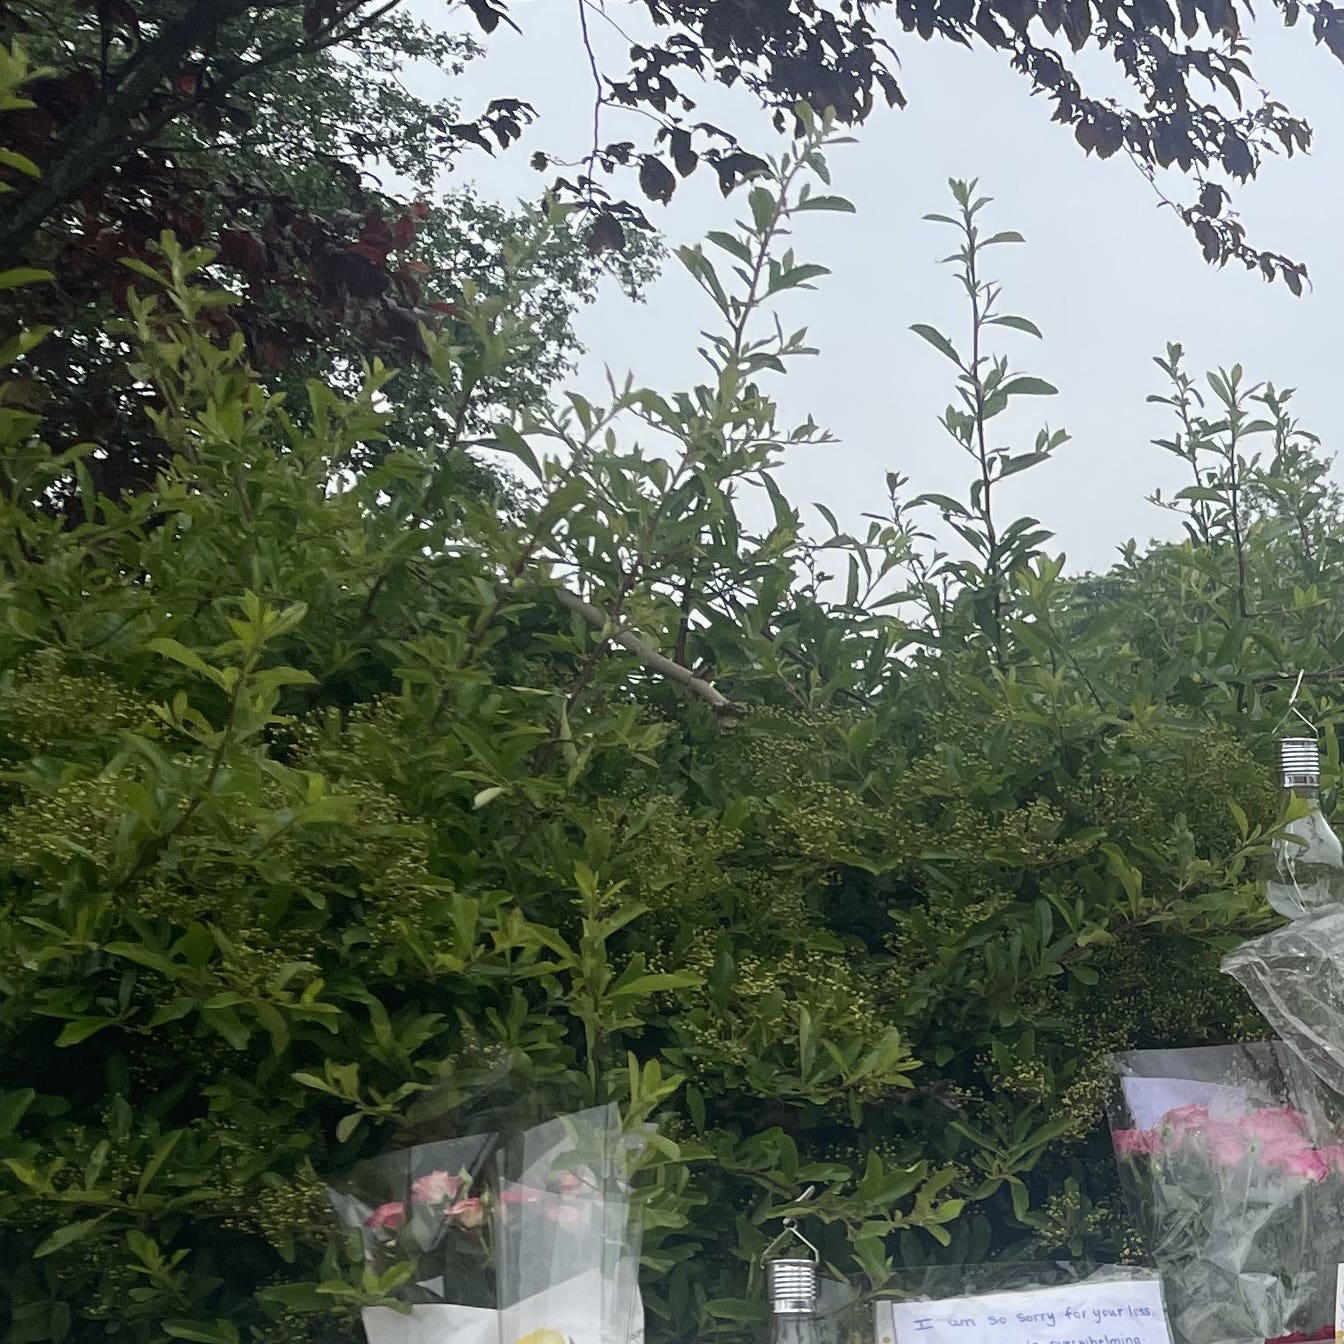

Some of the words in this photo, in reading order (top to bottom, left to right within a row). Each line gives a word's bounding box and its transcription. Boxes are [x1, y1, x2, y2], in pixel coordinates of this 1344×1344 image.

[948, 1314, 977, 1328] am
[1063, 1307, 1088, 1321] for
[1092, 1307, 1124, 1324] your
